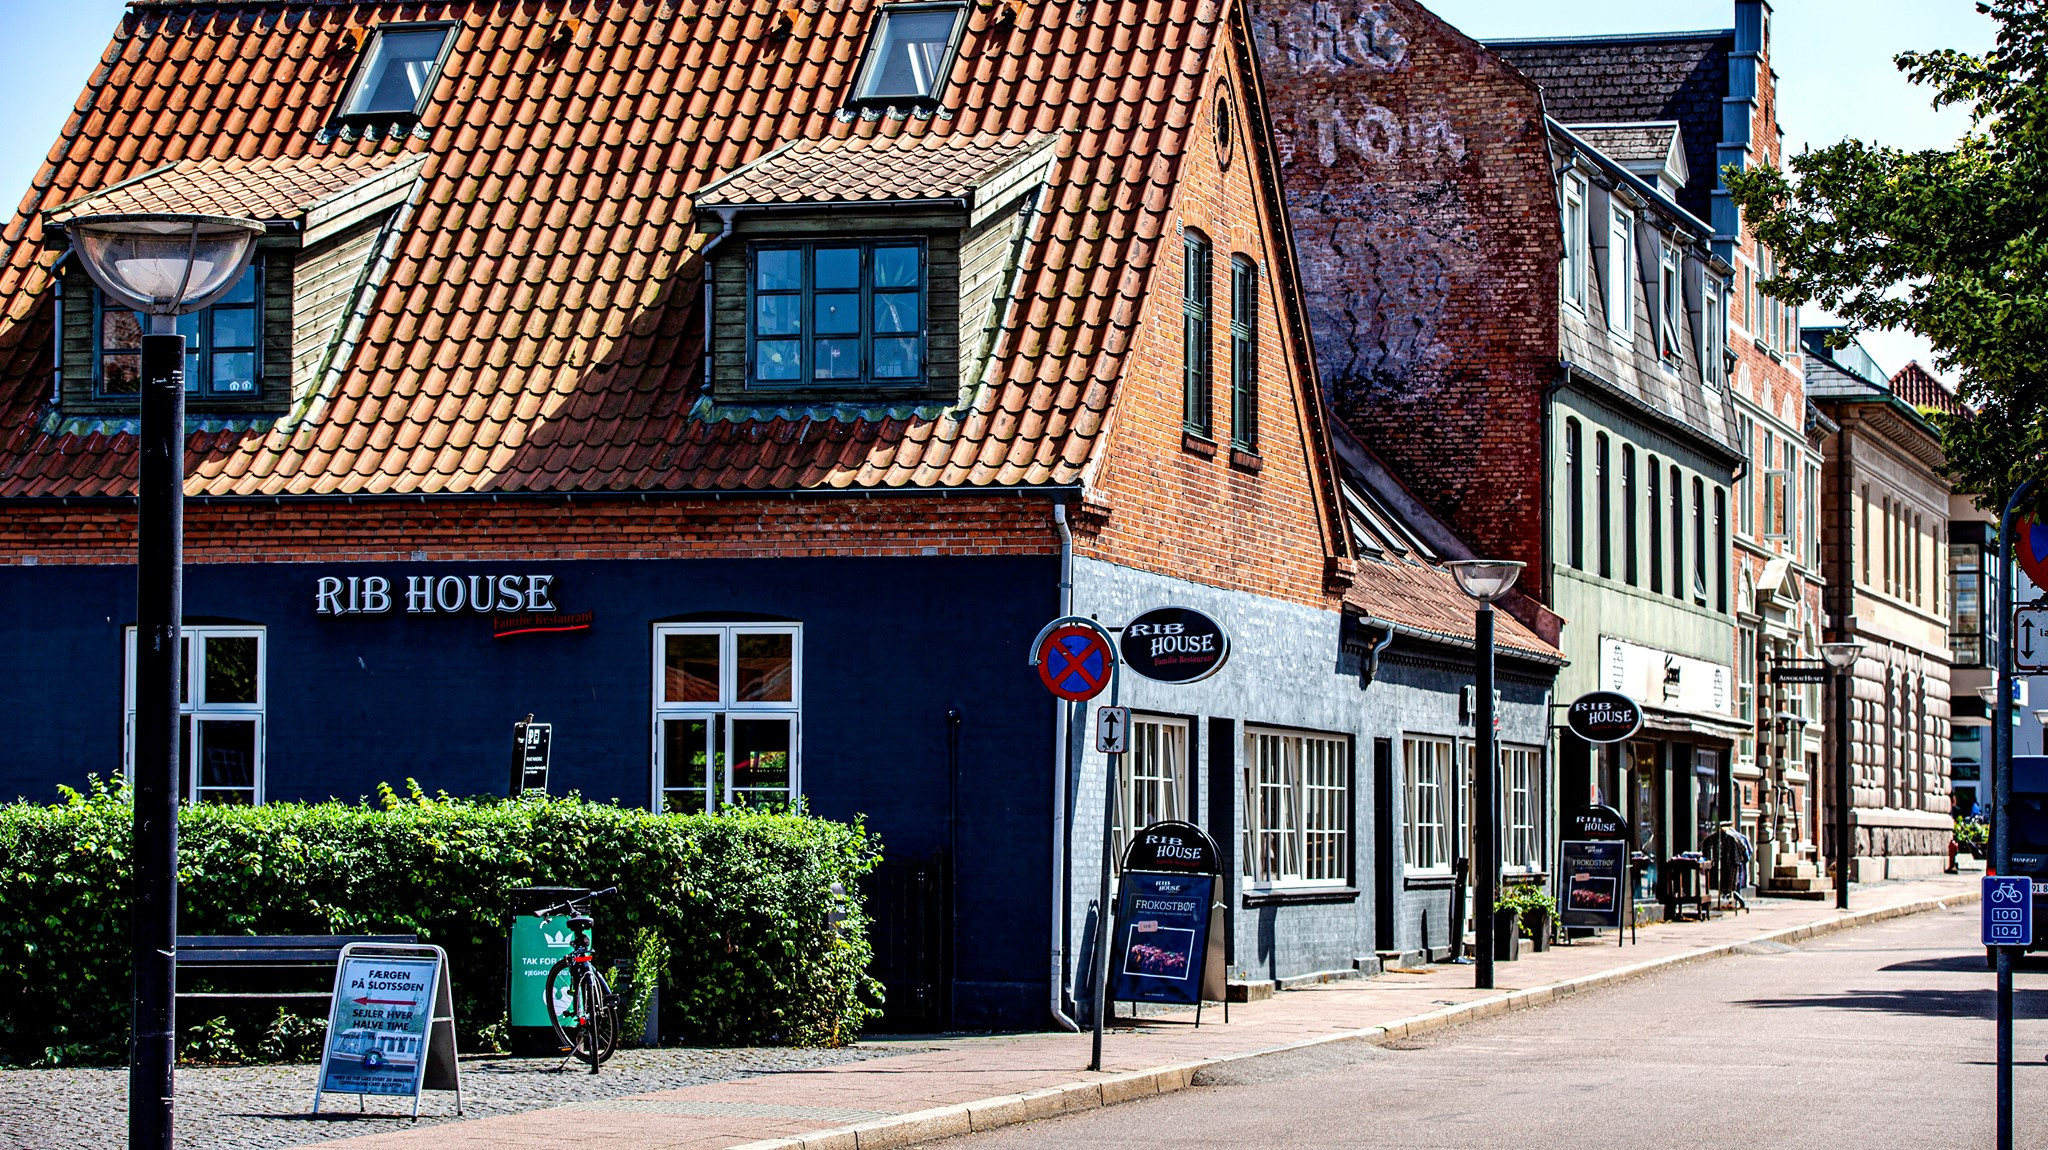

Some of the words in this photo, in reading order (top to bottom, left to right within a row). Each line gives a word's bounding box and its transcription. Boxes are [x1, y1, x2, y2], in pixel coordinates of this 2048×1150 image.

[315, 576, 392, 616] RIB
[405, 575, 557, 613] HOUSE
[494, 614, 533, 631] Familie
[535, 610, 593, 625] Restaurant
[1129, 623, 1185, 637] RIB
[1151, 634, 1216, 657] HOUSE
[1154, 655, 1178, 666] Familie
[1179, 653, 1214, 663] Restaurant
[1575, 702, 1612, 711] RIB
[1589, 709, 1632, 725] HOUSE
[1584, 822, 1616, 832] HOUSE
[1145, 834, 1183, 846] RIB
[1156, 845, 1202, 859] HOUSE
[1135, 899, 1196, 911] FROKOSTBØF
[1995, 910, 2018, 920] 100
[1995, 926, 2018, 936] 104
[522, 957, 538, 965] TAK
[540, 957, 557, 965] FOR
[368, 969, 411, 980] FÆRGEN
[351, 977, 365, 989] PÅ
[368, 980, 424, 991] SLOTSSØEN
[352, 1008, 384, 1018] SEJLER
[386, 1010, 413, 1020] HVER
[352, 1020, 384, 1029] HALVE
[387, 1022, 409, 1030] TIME
